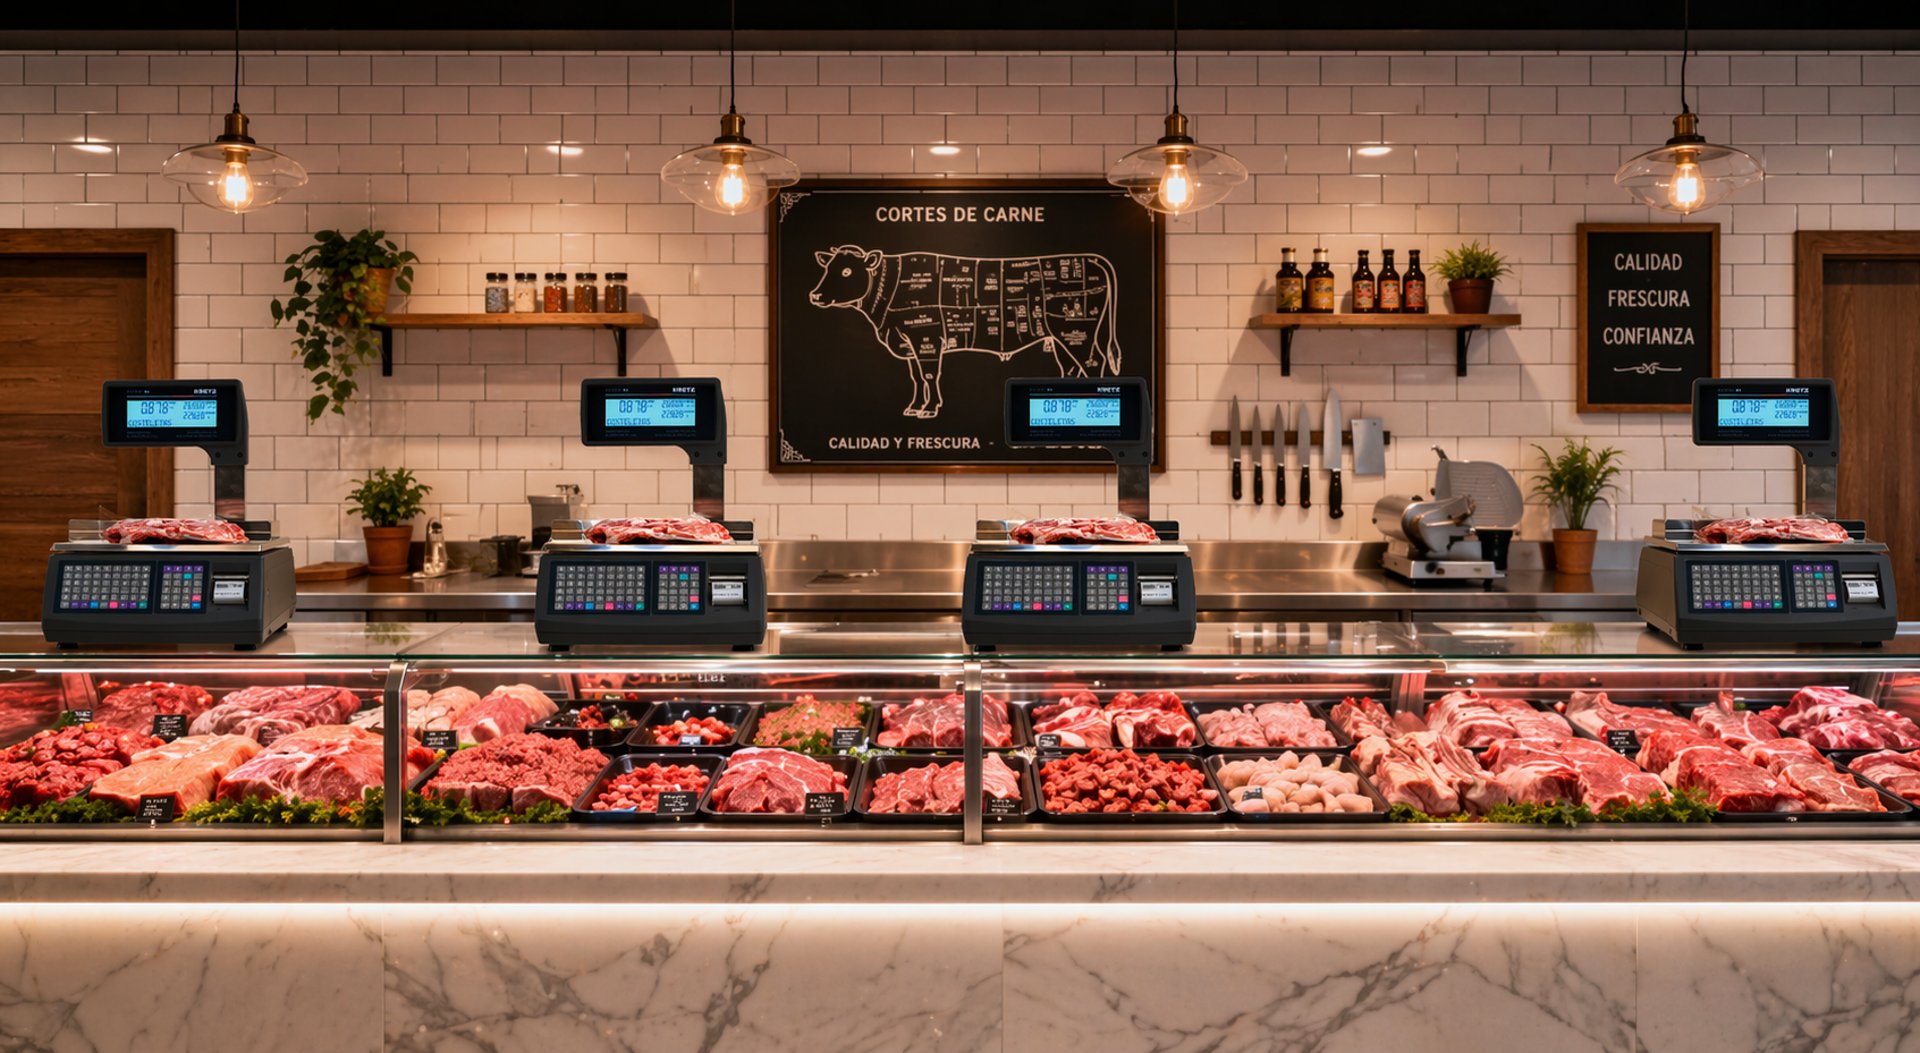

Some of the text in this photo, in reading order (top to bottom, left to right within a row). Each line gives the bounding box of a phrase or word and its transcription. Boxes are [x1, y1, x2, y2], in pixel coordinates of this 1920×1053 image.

[875, 206, 1045, 223] CORTES DE CARNE
[1614, 253, 1683, 271] CALIDAD
[1608, 289, 1691, 308] FRESCURA
[1603, 327, 1695, 345] CONFIANZA
[828, 436, 890, 450] CALIDAD
[893, 436, 903, 450] Y
[907, 436, 981, 450] FRESCURA
